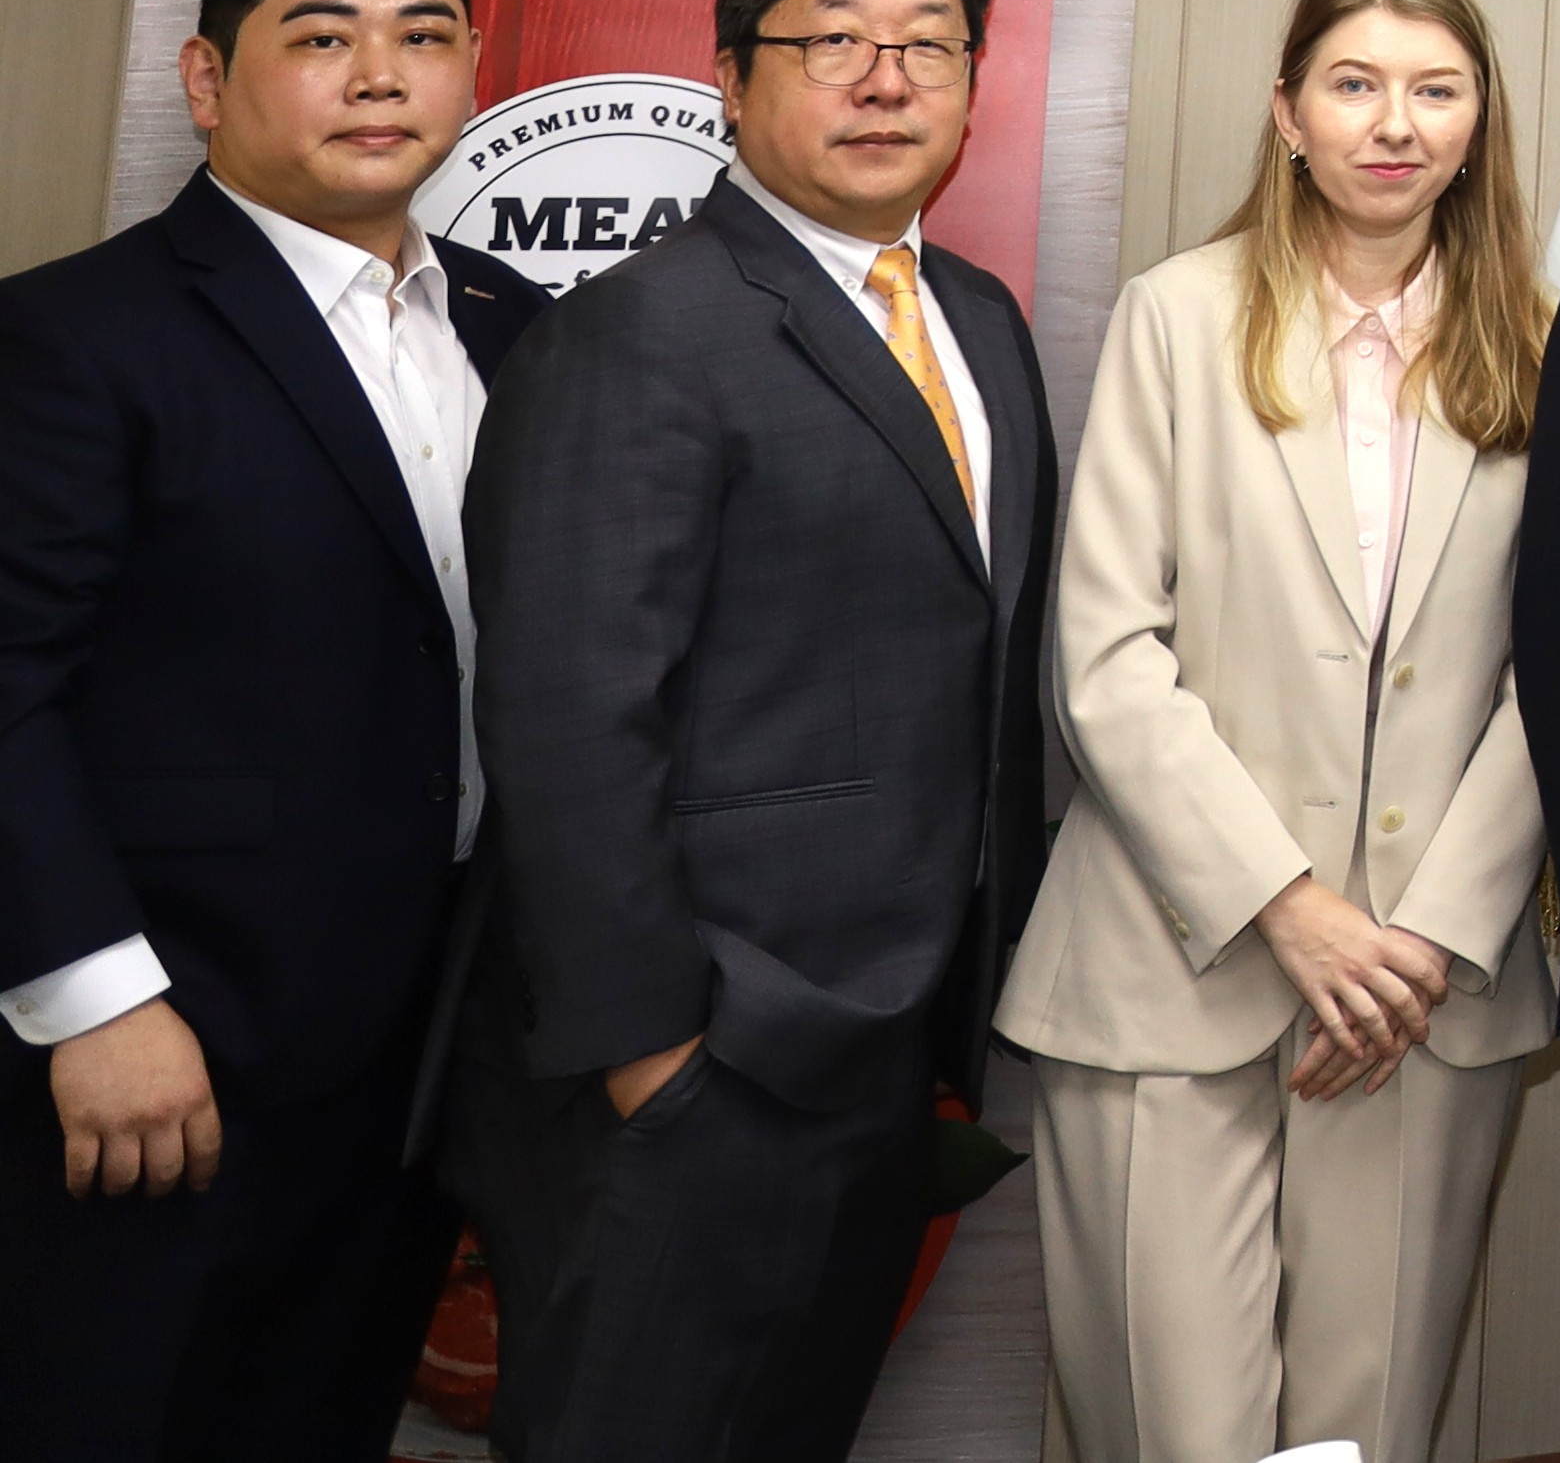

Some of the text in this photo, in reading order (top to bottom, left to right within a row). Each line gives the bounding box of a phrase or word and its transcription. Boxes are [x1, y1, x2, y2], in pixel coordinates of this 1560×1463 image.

[468, 102, 737, 172] PREMIUM QUAL
[487, 196, 706, 251] MEA
